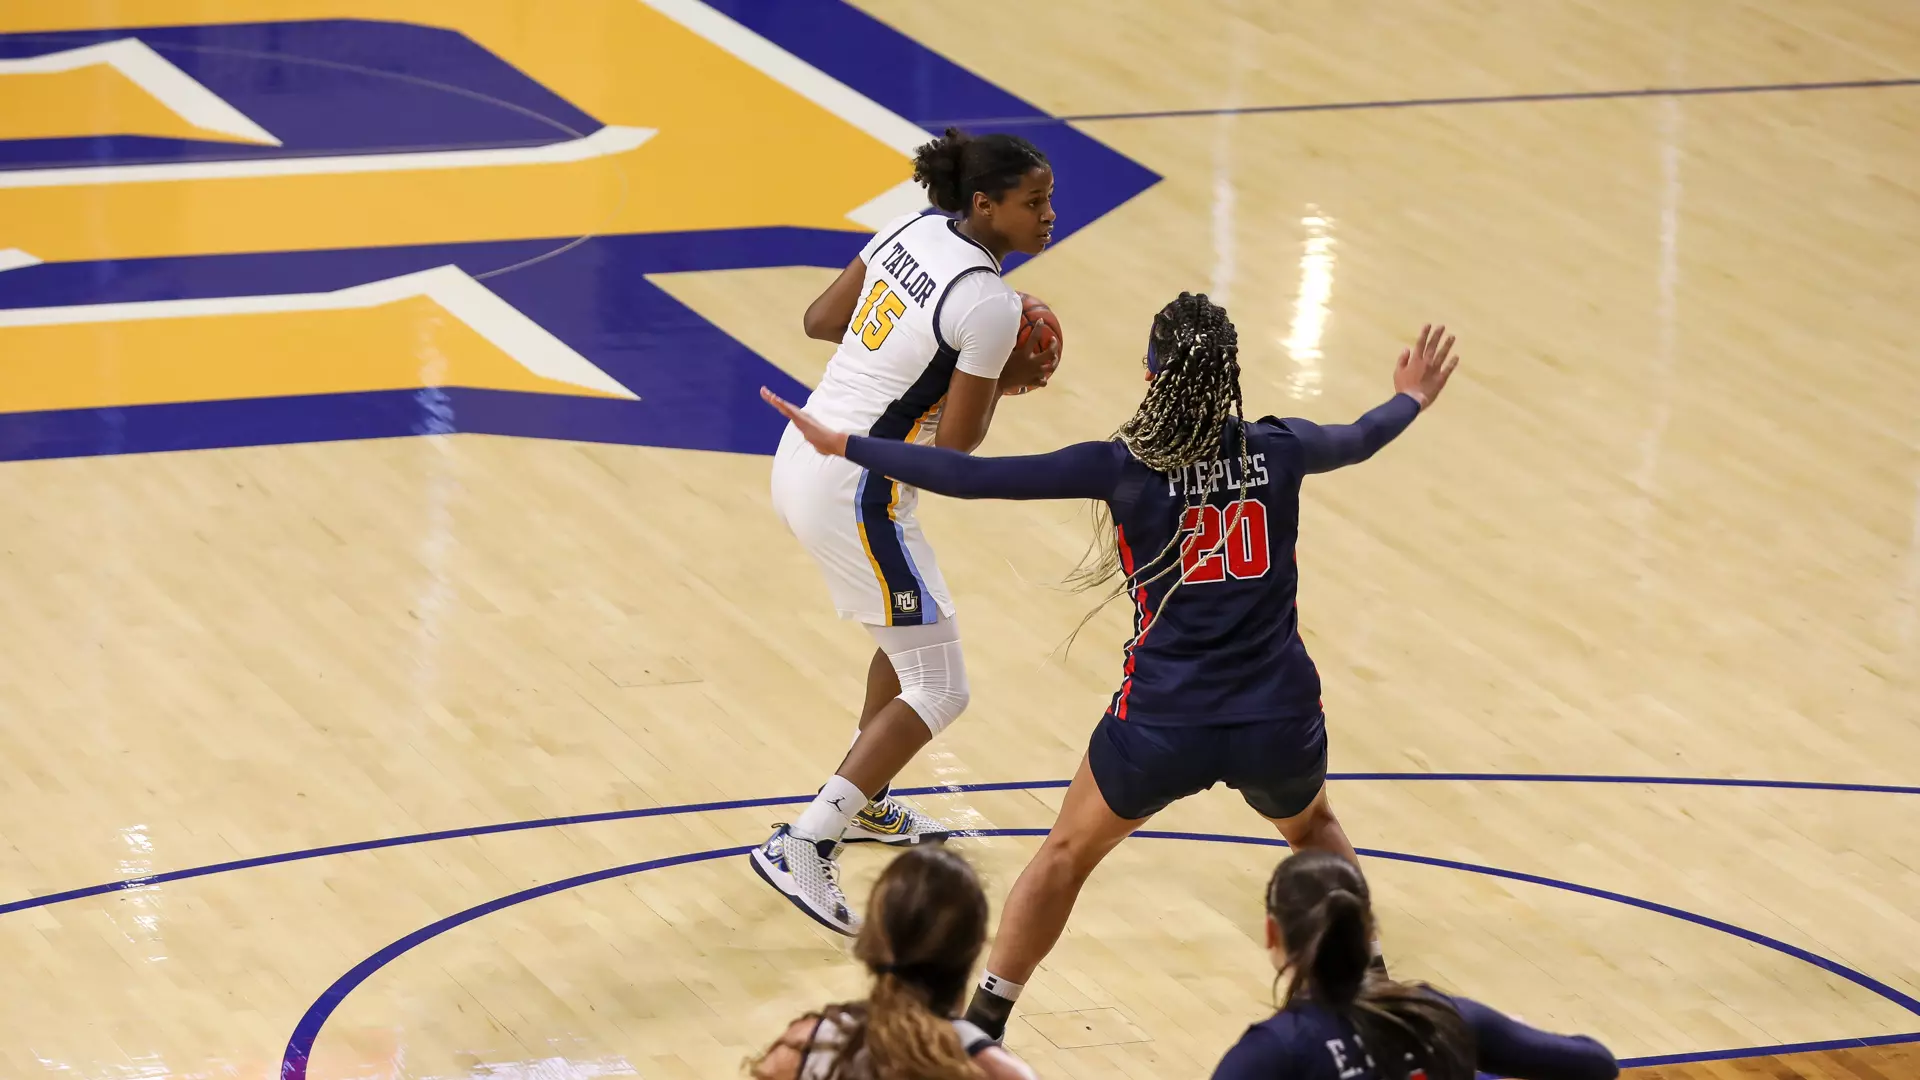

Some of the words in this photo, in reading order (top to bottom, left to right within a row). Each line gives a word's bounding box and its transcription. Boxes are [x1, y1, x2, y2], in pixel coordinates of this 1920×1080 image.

[881, 241, 937, 308] TAYLOR
[851, 279, 907, 352] 15
[1179, 498, 1271, 585] 20
[894, 591, 918, 612] MU
